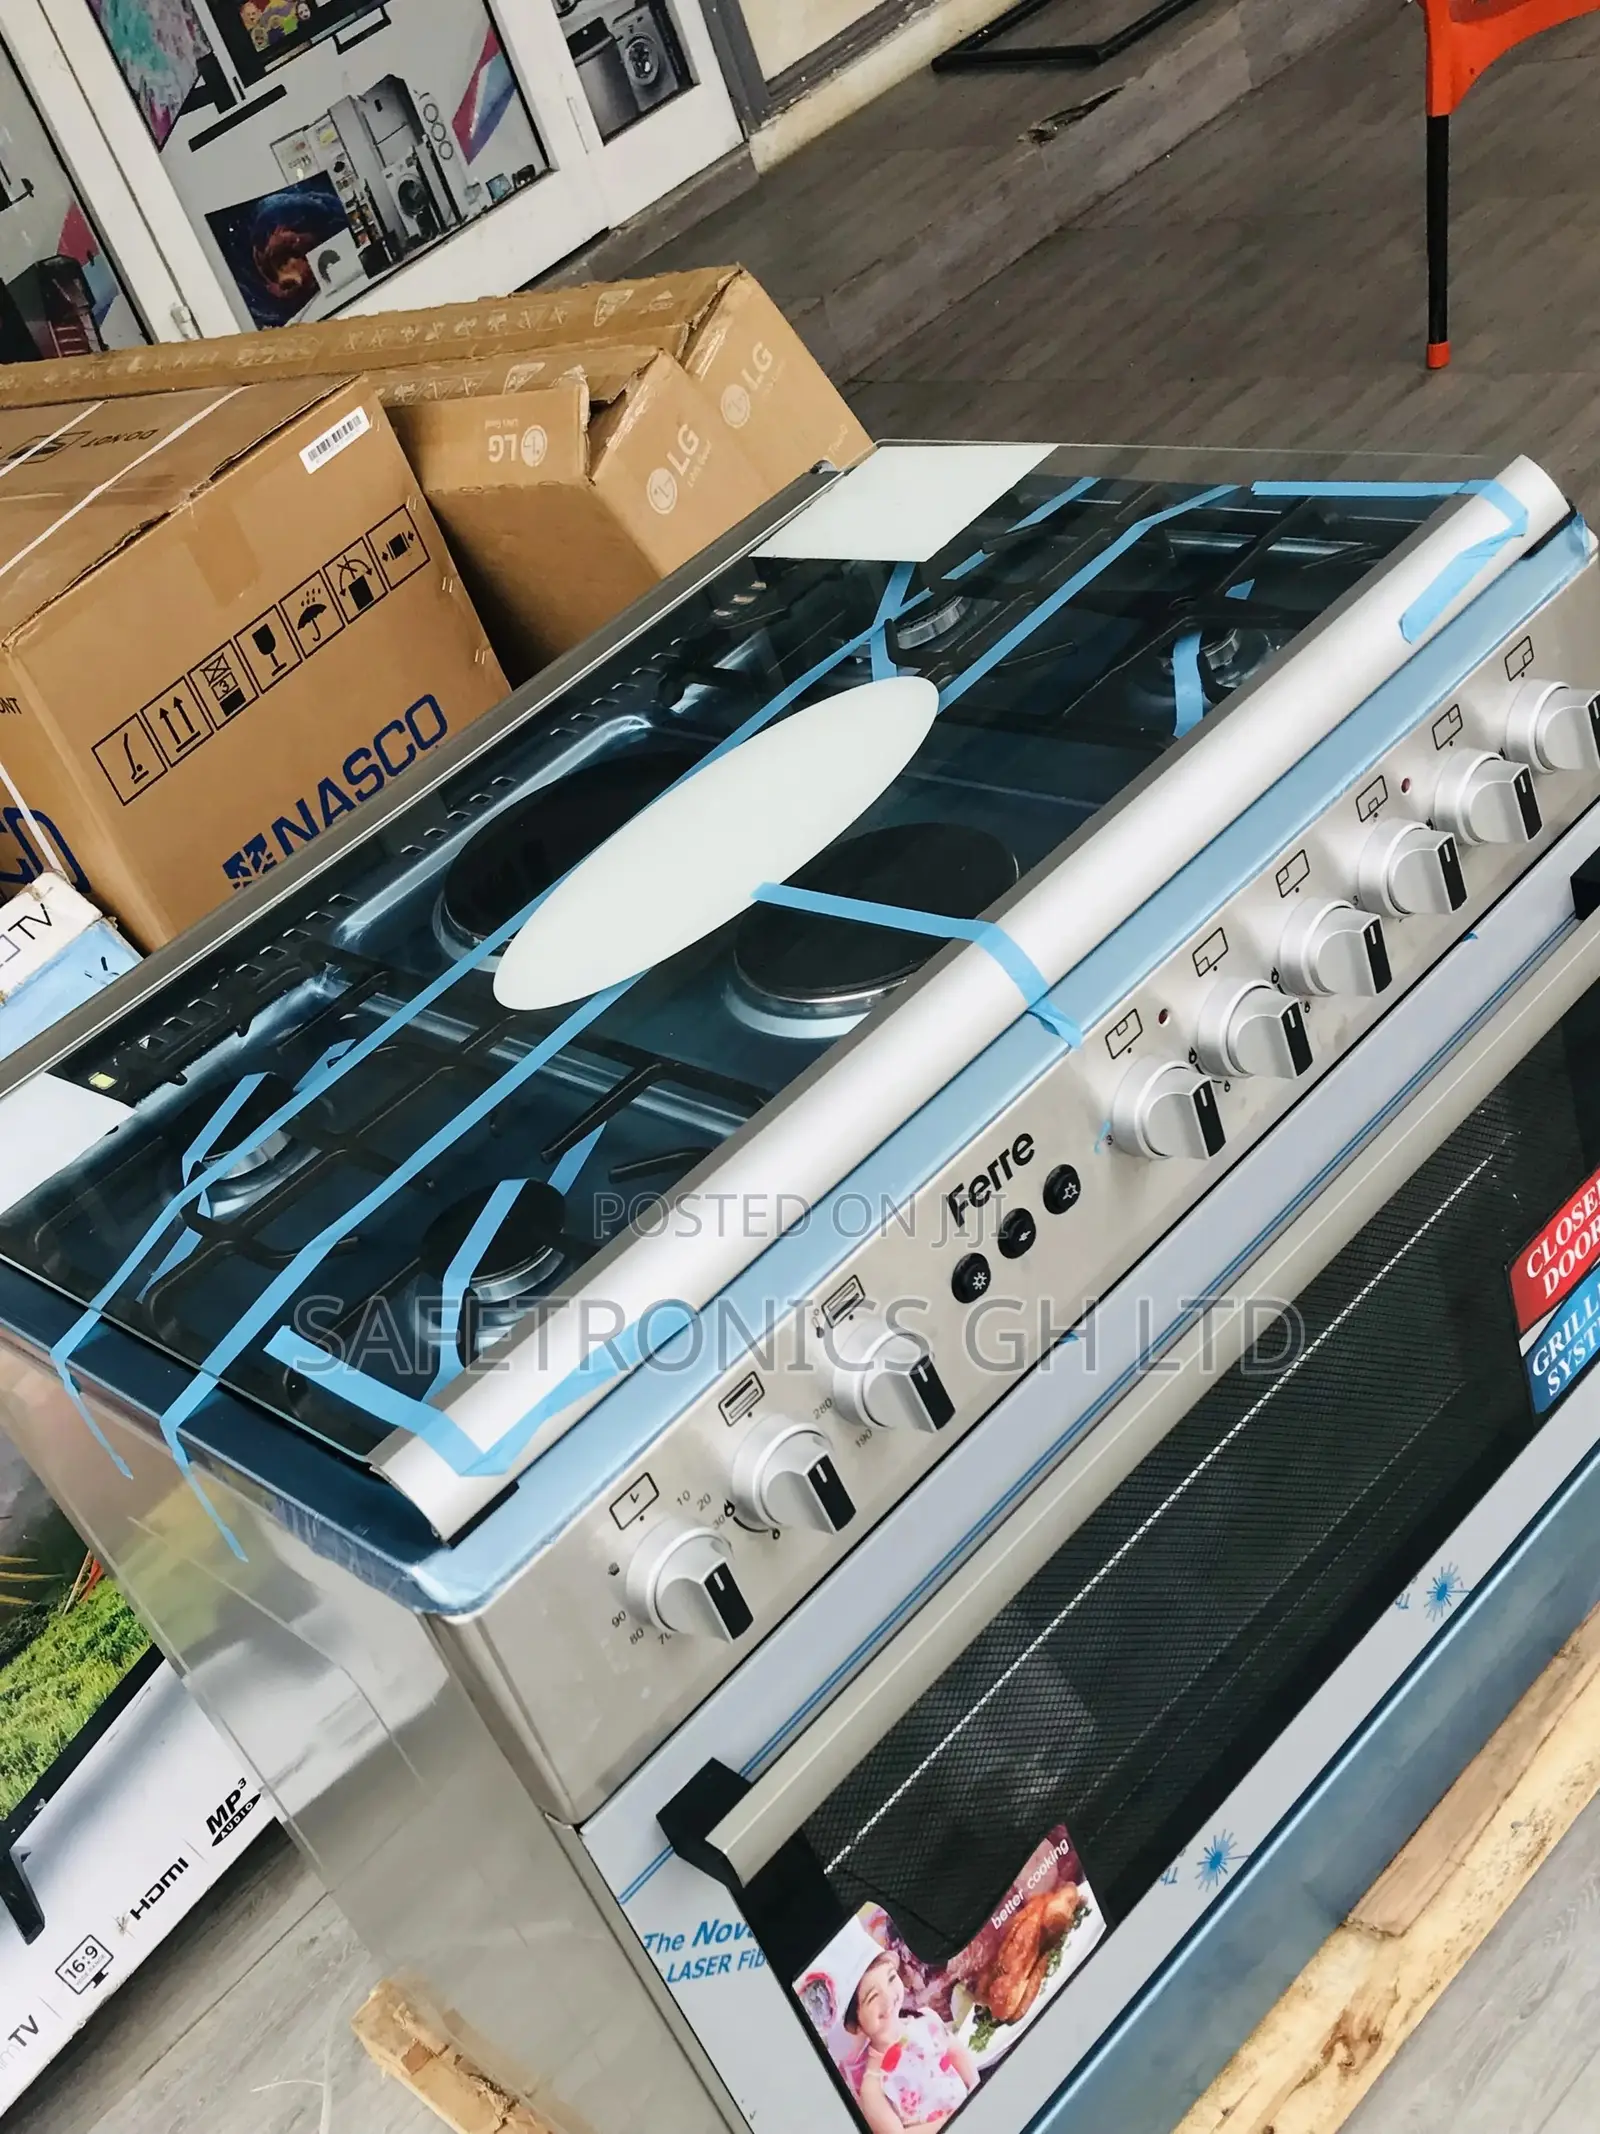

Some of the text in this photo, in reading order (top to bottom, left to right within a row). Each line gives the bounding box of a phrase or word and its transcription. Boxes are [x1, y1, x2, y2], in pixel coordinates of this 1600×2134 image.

[740, 341, 773, 390] LG
[488, 432, 518, 463] LG
[666, 423, 700, 476] LG
[271, 693, 448, 857] NASCO
[8, 902, 52, 940] TV
[945, 1133, 1036, 1228] Ferre
[1532, 1282, 1600, 1377] GRILL
[1547, 1315, 1600, 1397] SYST
[813, 1397, 833, 1420] 280
[676, 1489, 690, 1506] 10
[696, 1492, 711, 1511] 20
[713, 1513, 726, 1530] 30
[611, 1610, 626, 1628] 90
[629, 1627, 644, 1645] 80
[220, 1801, 255, 1840] AUDIO
[129, 1856, 189, 1921] HDMI
[990, 1838, 1070, 1931] better cooking
[643, 1931, 685, 1955] The
[64, 1945, 98, 1980] 16:9
[667, 1953, 732, 1983] LASER
